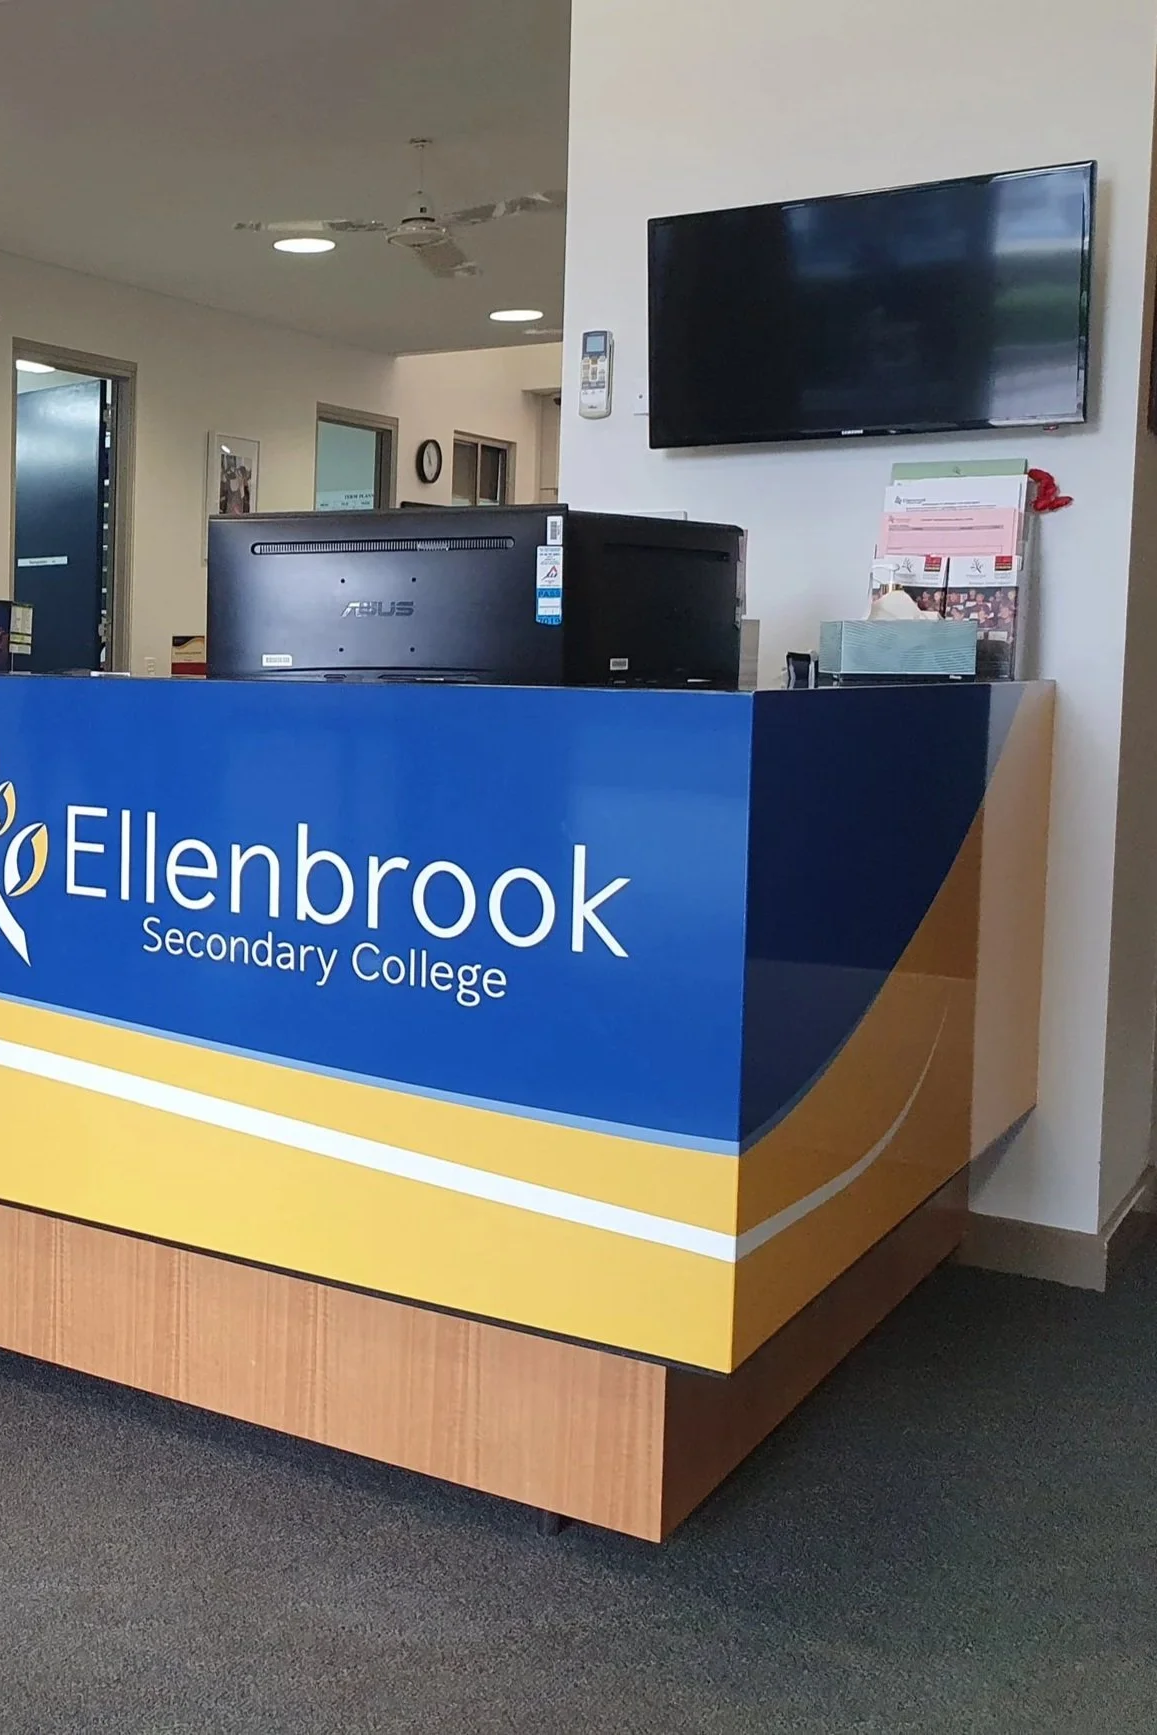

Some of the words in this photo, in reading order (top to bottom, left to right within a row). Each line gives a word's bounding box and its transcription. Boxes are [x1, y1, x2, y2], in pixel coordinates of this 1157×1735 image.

[340, 601, 414, 617] ASUS
[65, 804, 632, 959] Ellenbrook
[143, 916, 338, 987] Secondary
[351, 941, 508, 1008] College
